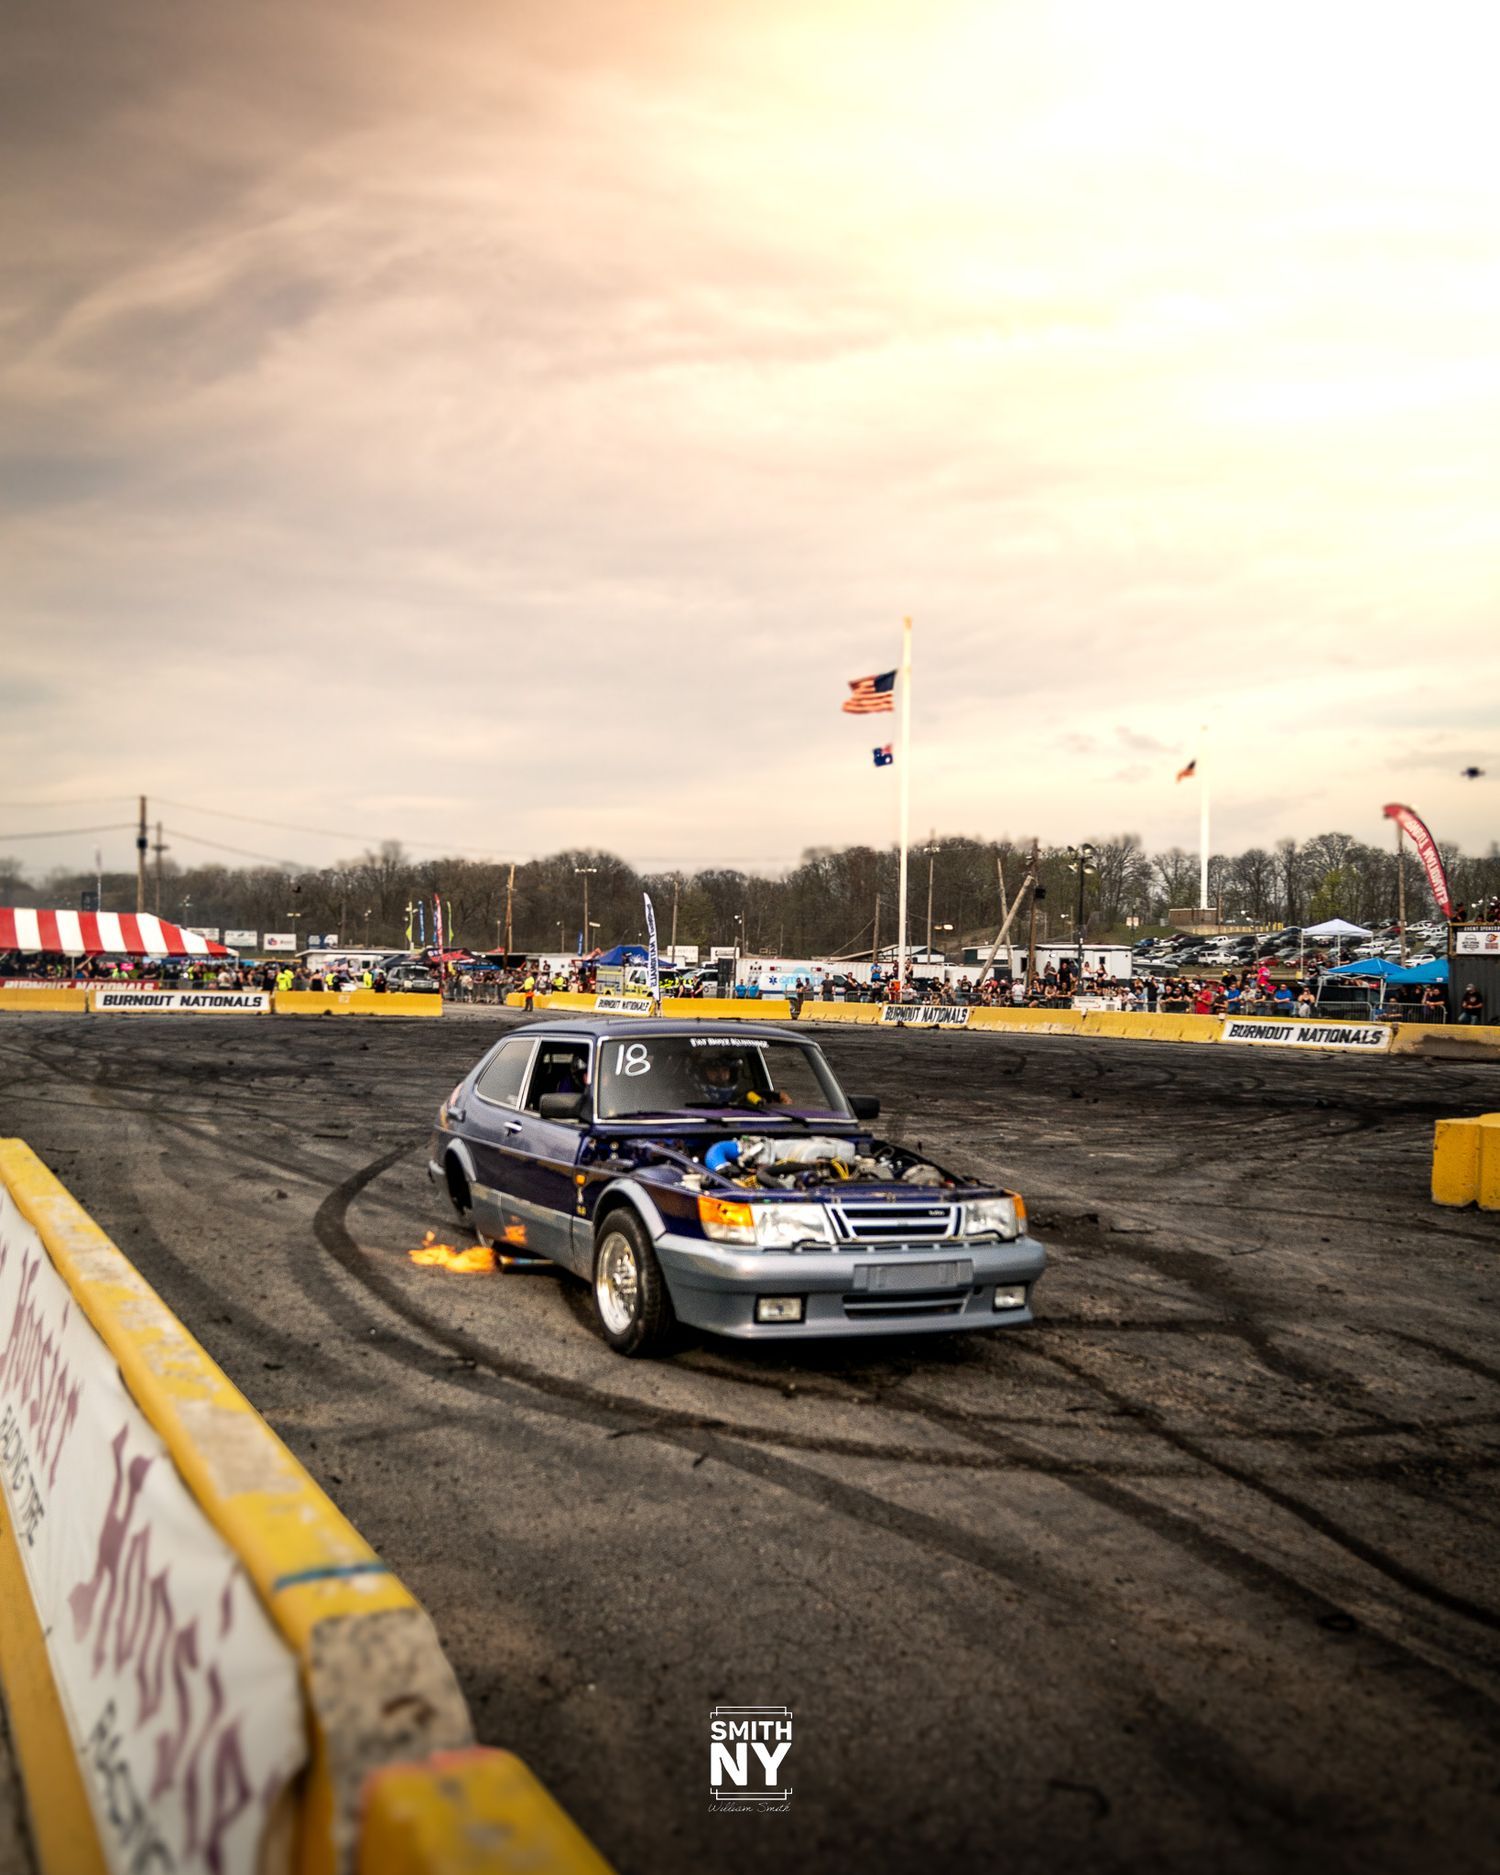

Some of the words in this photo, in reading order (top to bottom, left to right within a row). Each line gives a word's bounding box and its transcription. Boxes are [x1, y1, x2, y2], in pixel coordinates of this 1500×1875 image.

[103, 994, 175, 1007] BURNOUT
[180, 995, 263, 1008] NATIONALS
[885, 1006, 921, 1022] BURNOUT
[922, 1007, 968, 1024] NATIONALS
[1229, 1023, 1295, 1040] BURNOUT
[1297, 1027, 1384, 1045] NATIONALS
[615, 1043, 651, 1077] 18
[69, 1422, 283, 1875] Hoosie
